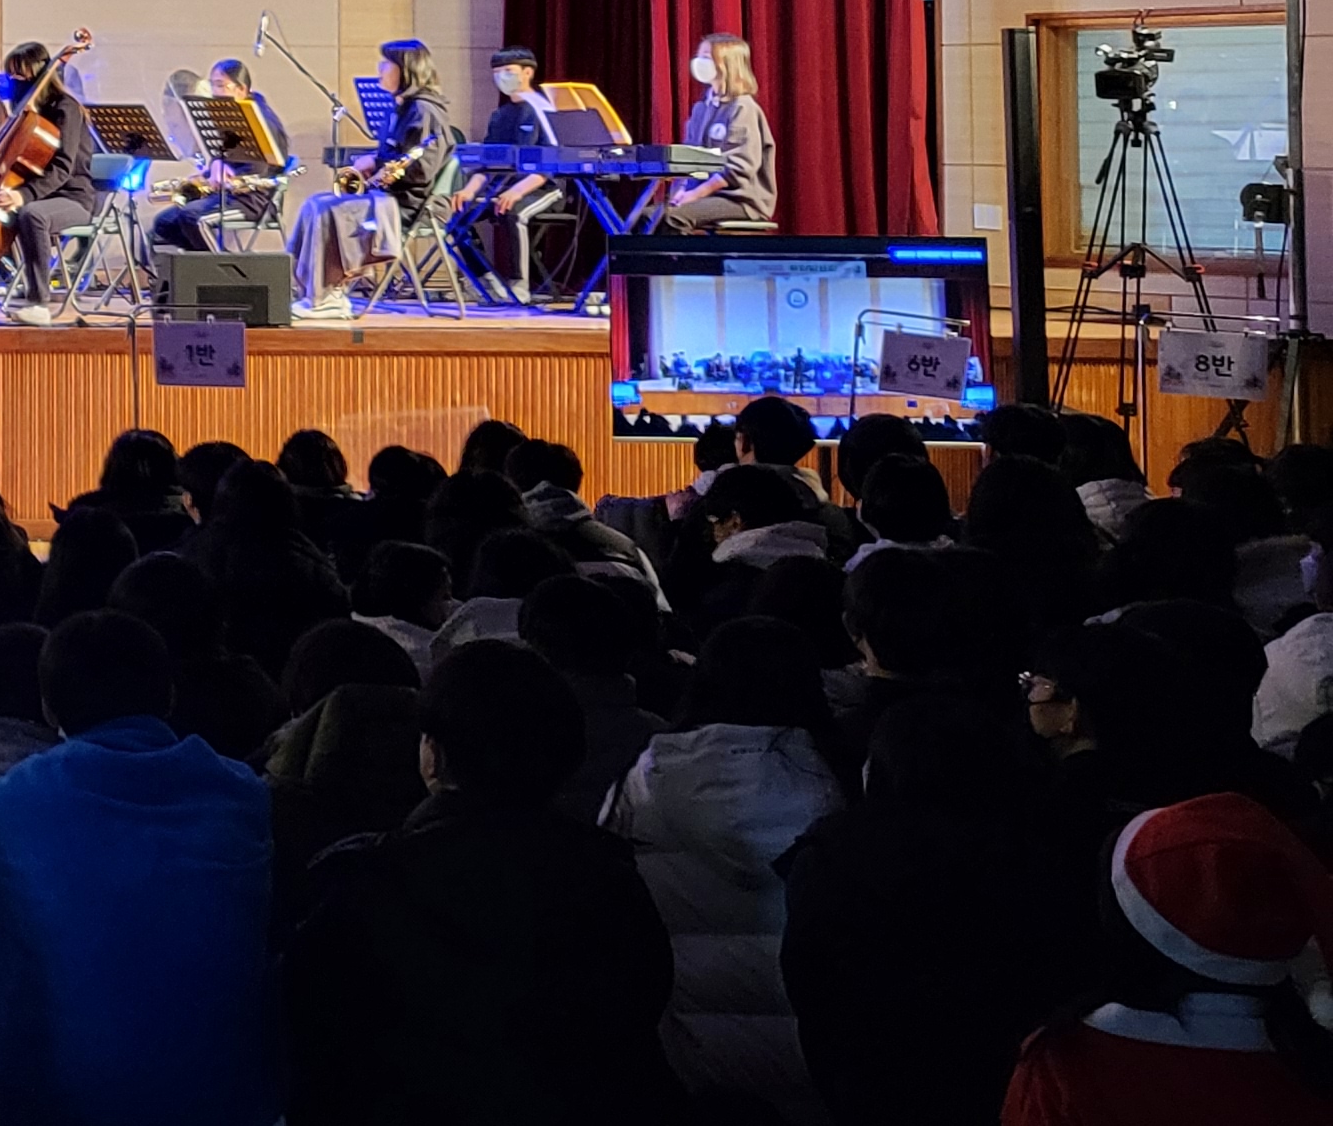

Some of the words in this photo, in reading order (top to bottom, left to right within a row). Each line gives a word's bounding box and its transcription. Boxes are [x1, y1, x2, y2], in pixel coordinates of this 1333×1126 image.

[185, 343, 217, 367] 1반
[907, 354, 941, 378] 6반
[1194, 354, 1235, 378] 8반
